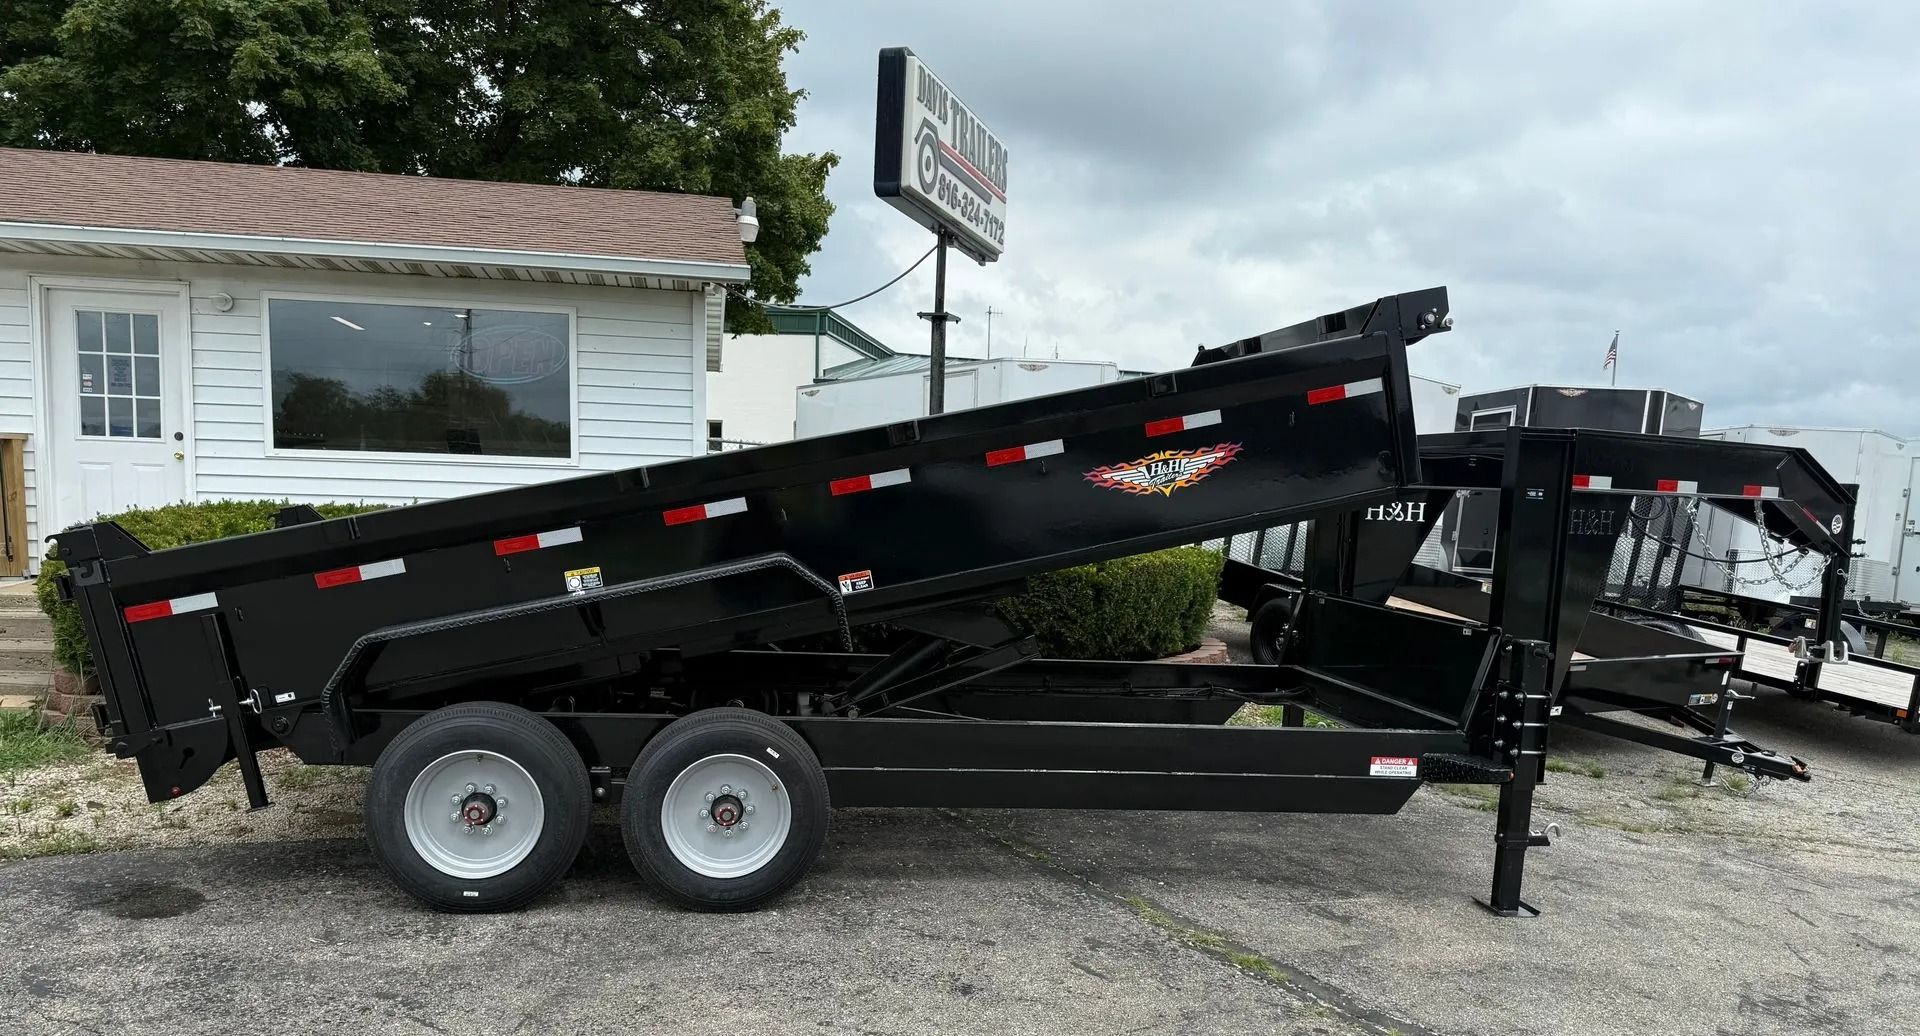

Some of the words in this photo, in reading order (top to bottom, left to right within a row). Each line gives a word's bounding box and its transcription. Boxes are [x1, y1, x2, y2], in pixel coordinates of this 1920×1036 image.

[917, 64, 949, 125] DAVIS
[950, 97, 1009, 193] TRAILERS
[938, 173, 1005, 246] 816-324-7172
[464, 335, 556, 375] OPEN
[1149, 471, 1184, 489] Trailers
[1150, 459, 1182, 476] H&H
[1365, 501, 1427, 522] H&H
[1568, 509, 1615, 535] H&H
